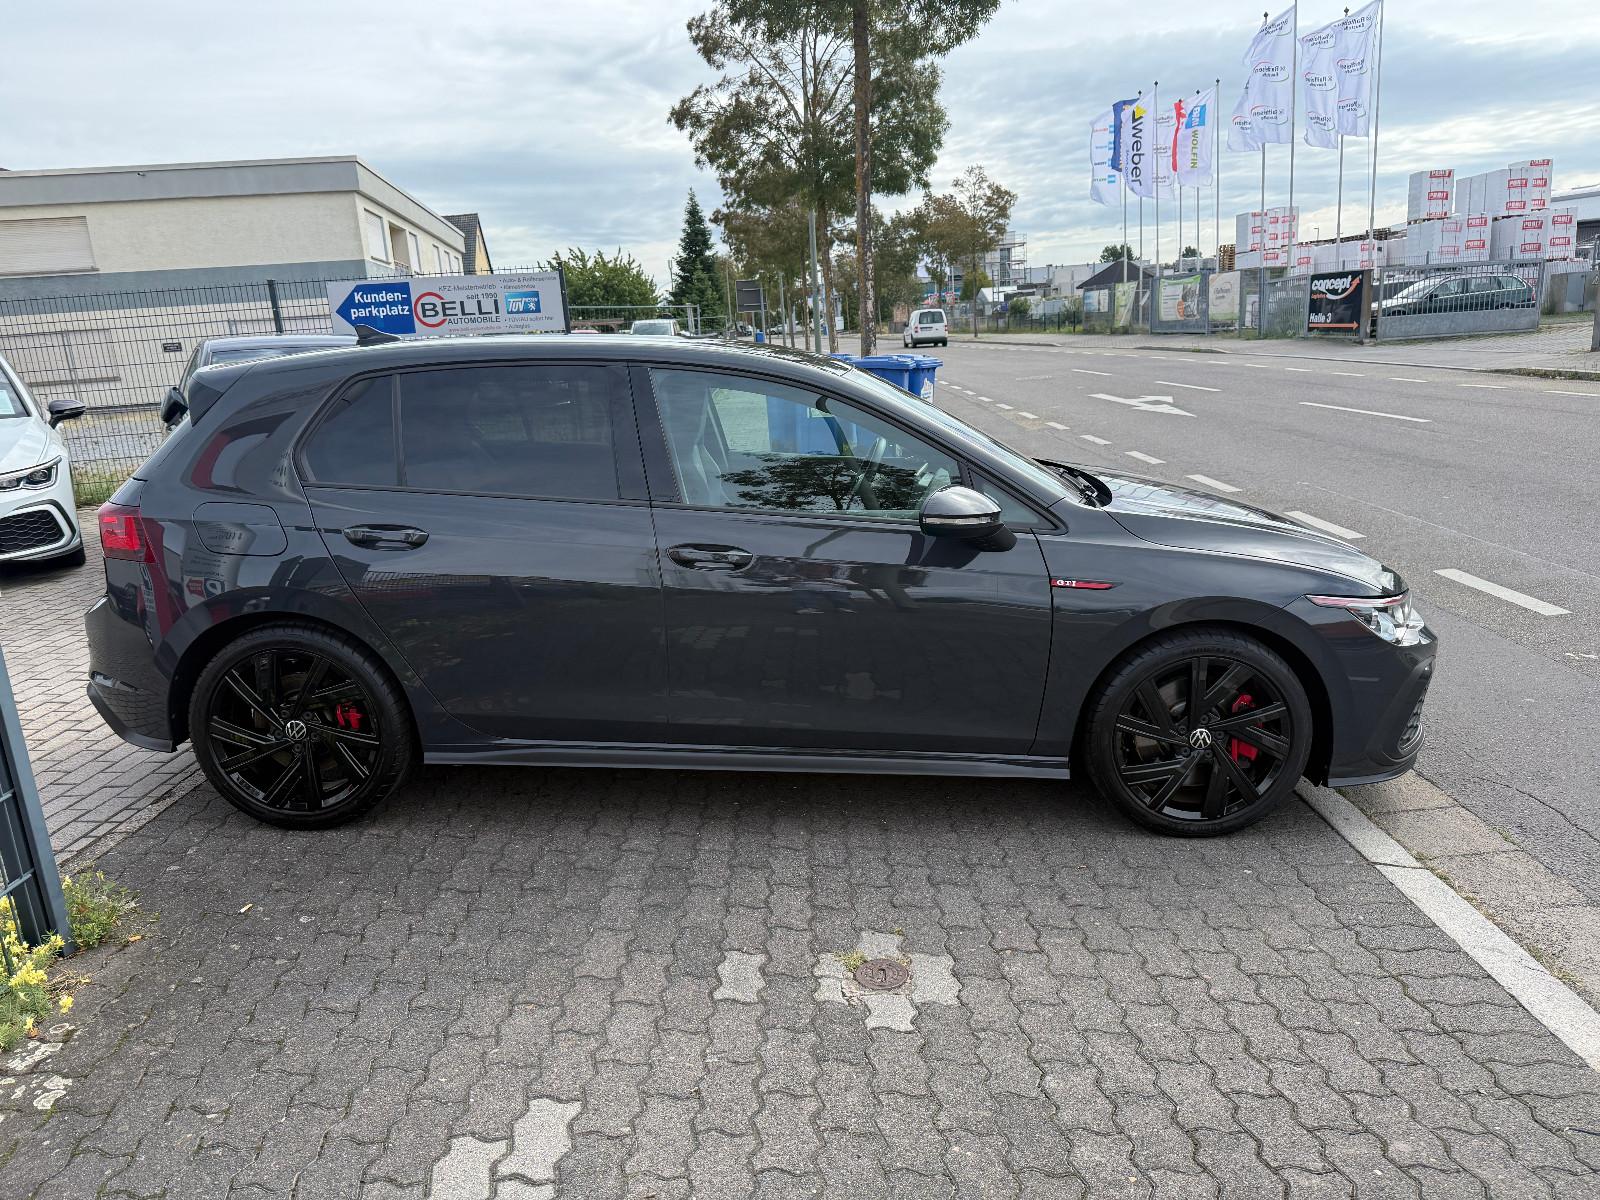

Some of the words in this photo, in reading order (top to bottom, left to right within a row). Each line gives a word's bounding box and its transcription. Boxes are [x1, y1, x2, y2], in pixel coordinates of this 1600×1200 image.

[1131, 121, 1144, 186] weber
[1191, 130, 1199, 169] WOLFIN
[1312, 275, 1352, 293] concept
[354, 291, 408, 304] Kunden-
[351, 305, 410, 320] parkplatz
[421, 299, 499, 318] BELLI
[448, 316, 501, 325] AUTOMOBILE
[1309, 313, 1325, 322] Halle
[1327, 313, 1331, 323] 3
[1056, 579, 1077, 587] GTI
